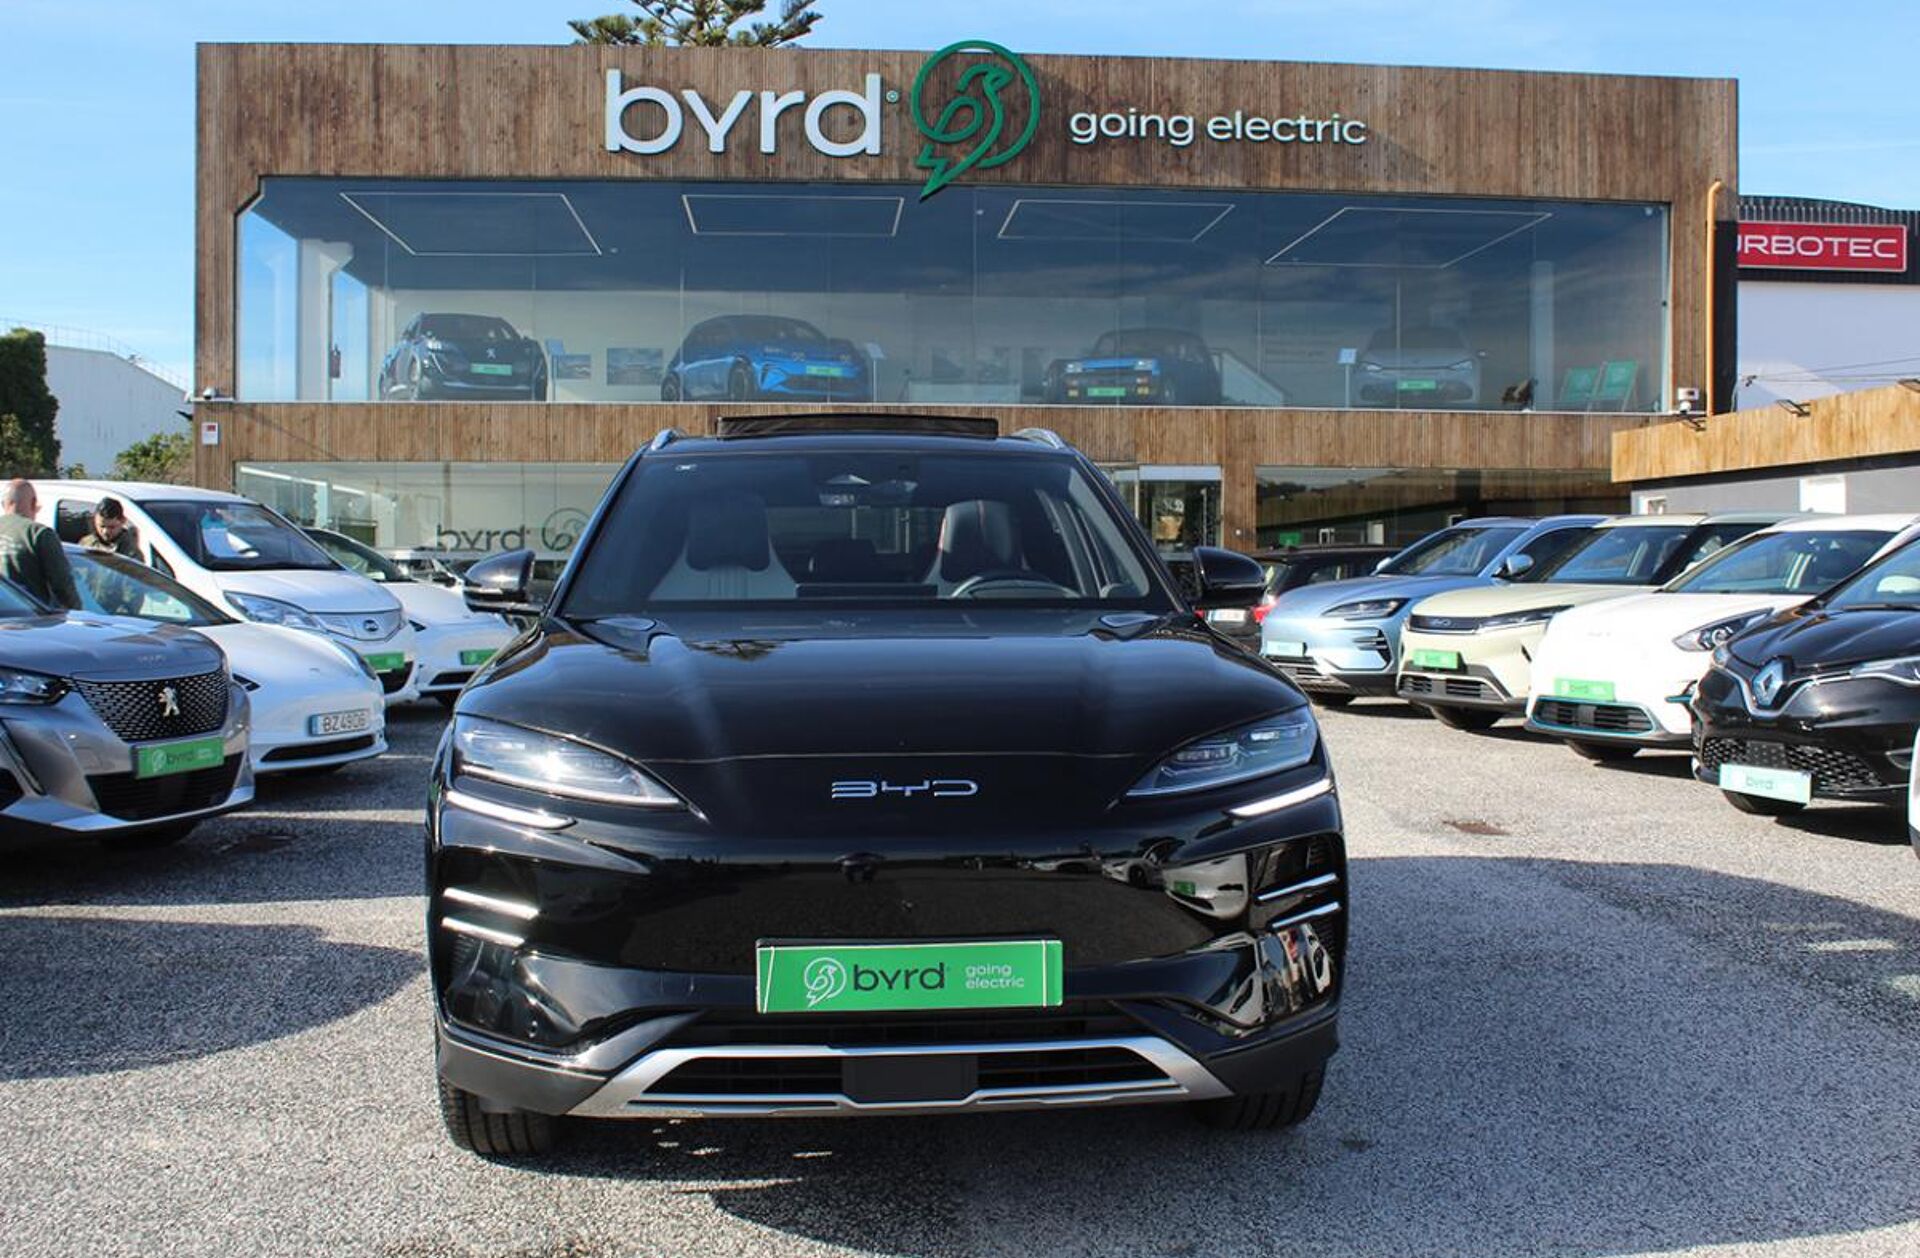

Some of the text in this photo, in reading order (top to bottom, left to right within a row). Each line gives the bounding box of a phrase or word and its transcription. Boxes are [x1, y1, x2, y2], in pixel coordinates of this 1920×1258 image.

[1069, 107, 1367, 146] going electric
[831, 779, 978, 799] BYD
[853, 962, 1012, 991] byrd going
[965, 976, 1025, 989] electric
